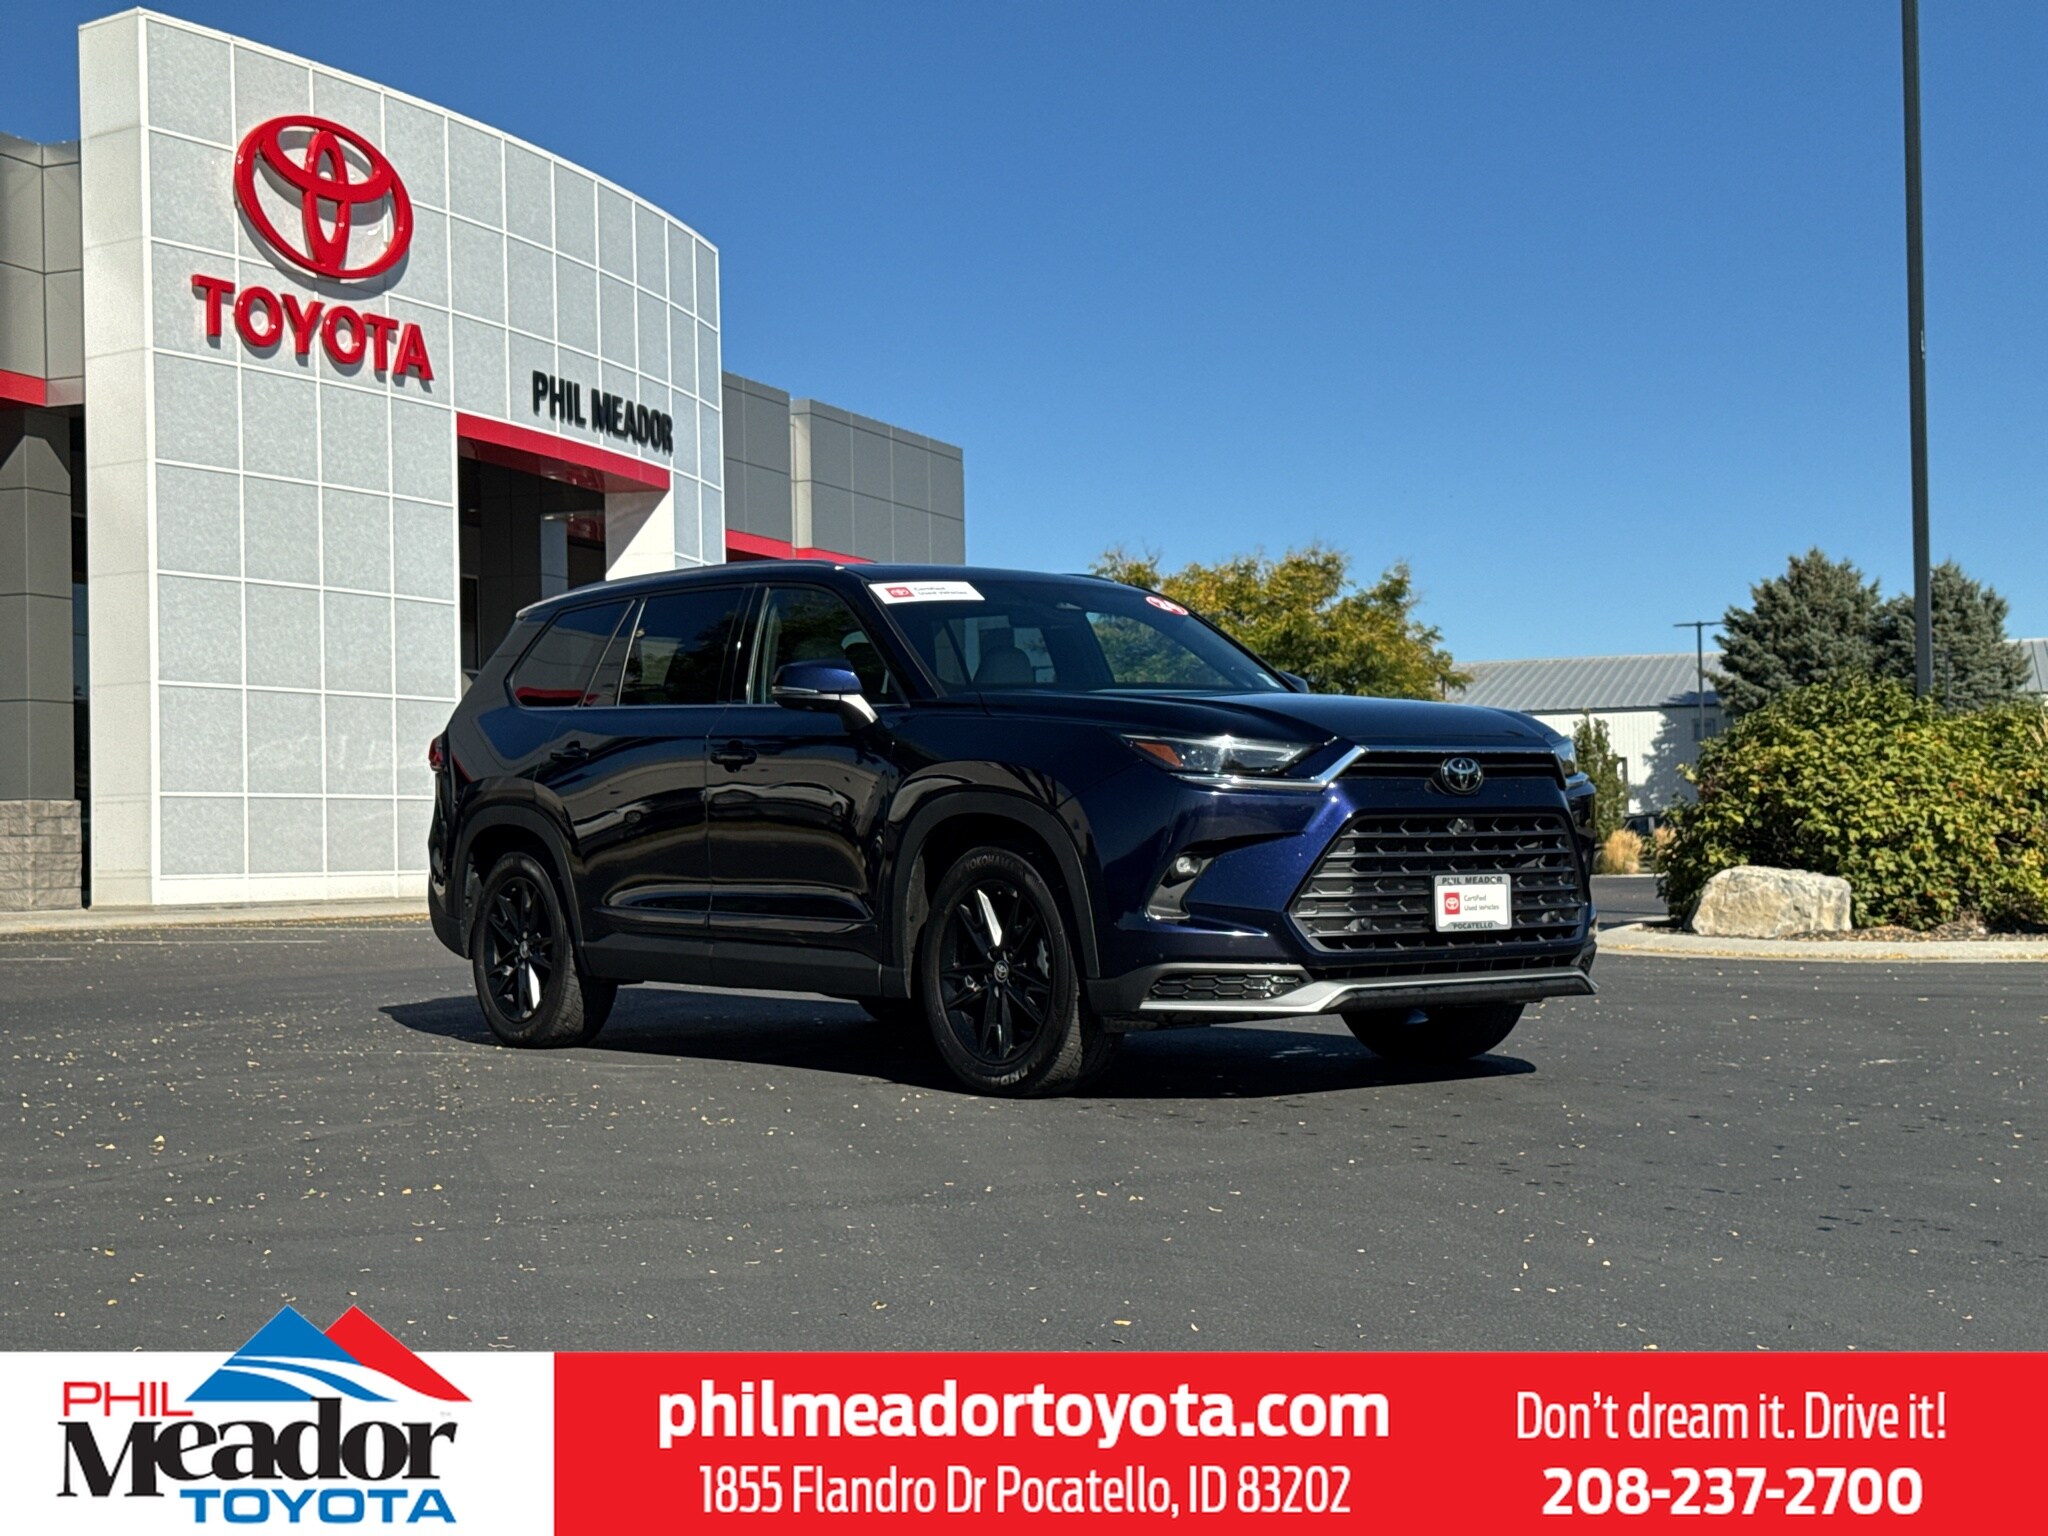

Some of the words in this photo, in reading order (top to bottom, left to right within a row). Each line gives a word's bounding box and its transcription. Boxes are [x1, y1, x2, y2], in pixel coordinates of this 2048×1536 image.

[191, 274, 434, 381] TOYOTA
[532, 370, 586, 426] PHIL
[591, 388, 673, 456] MEADOR
[1465, 876, 1503, 885] MEADOR
[1463, 893, 1487, 902] Certified
[1453, 922, 1493, 930] POCATELLO
